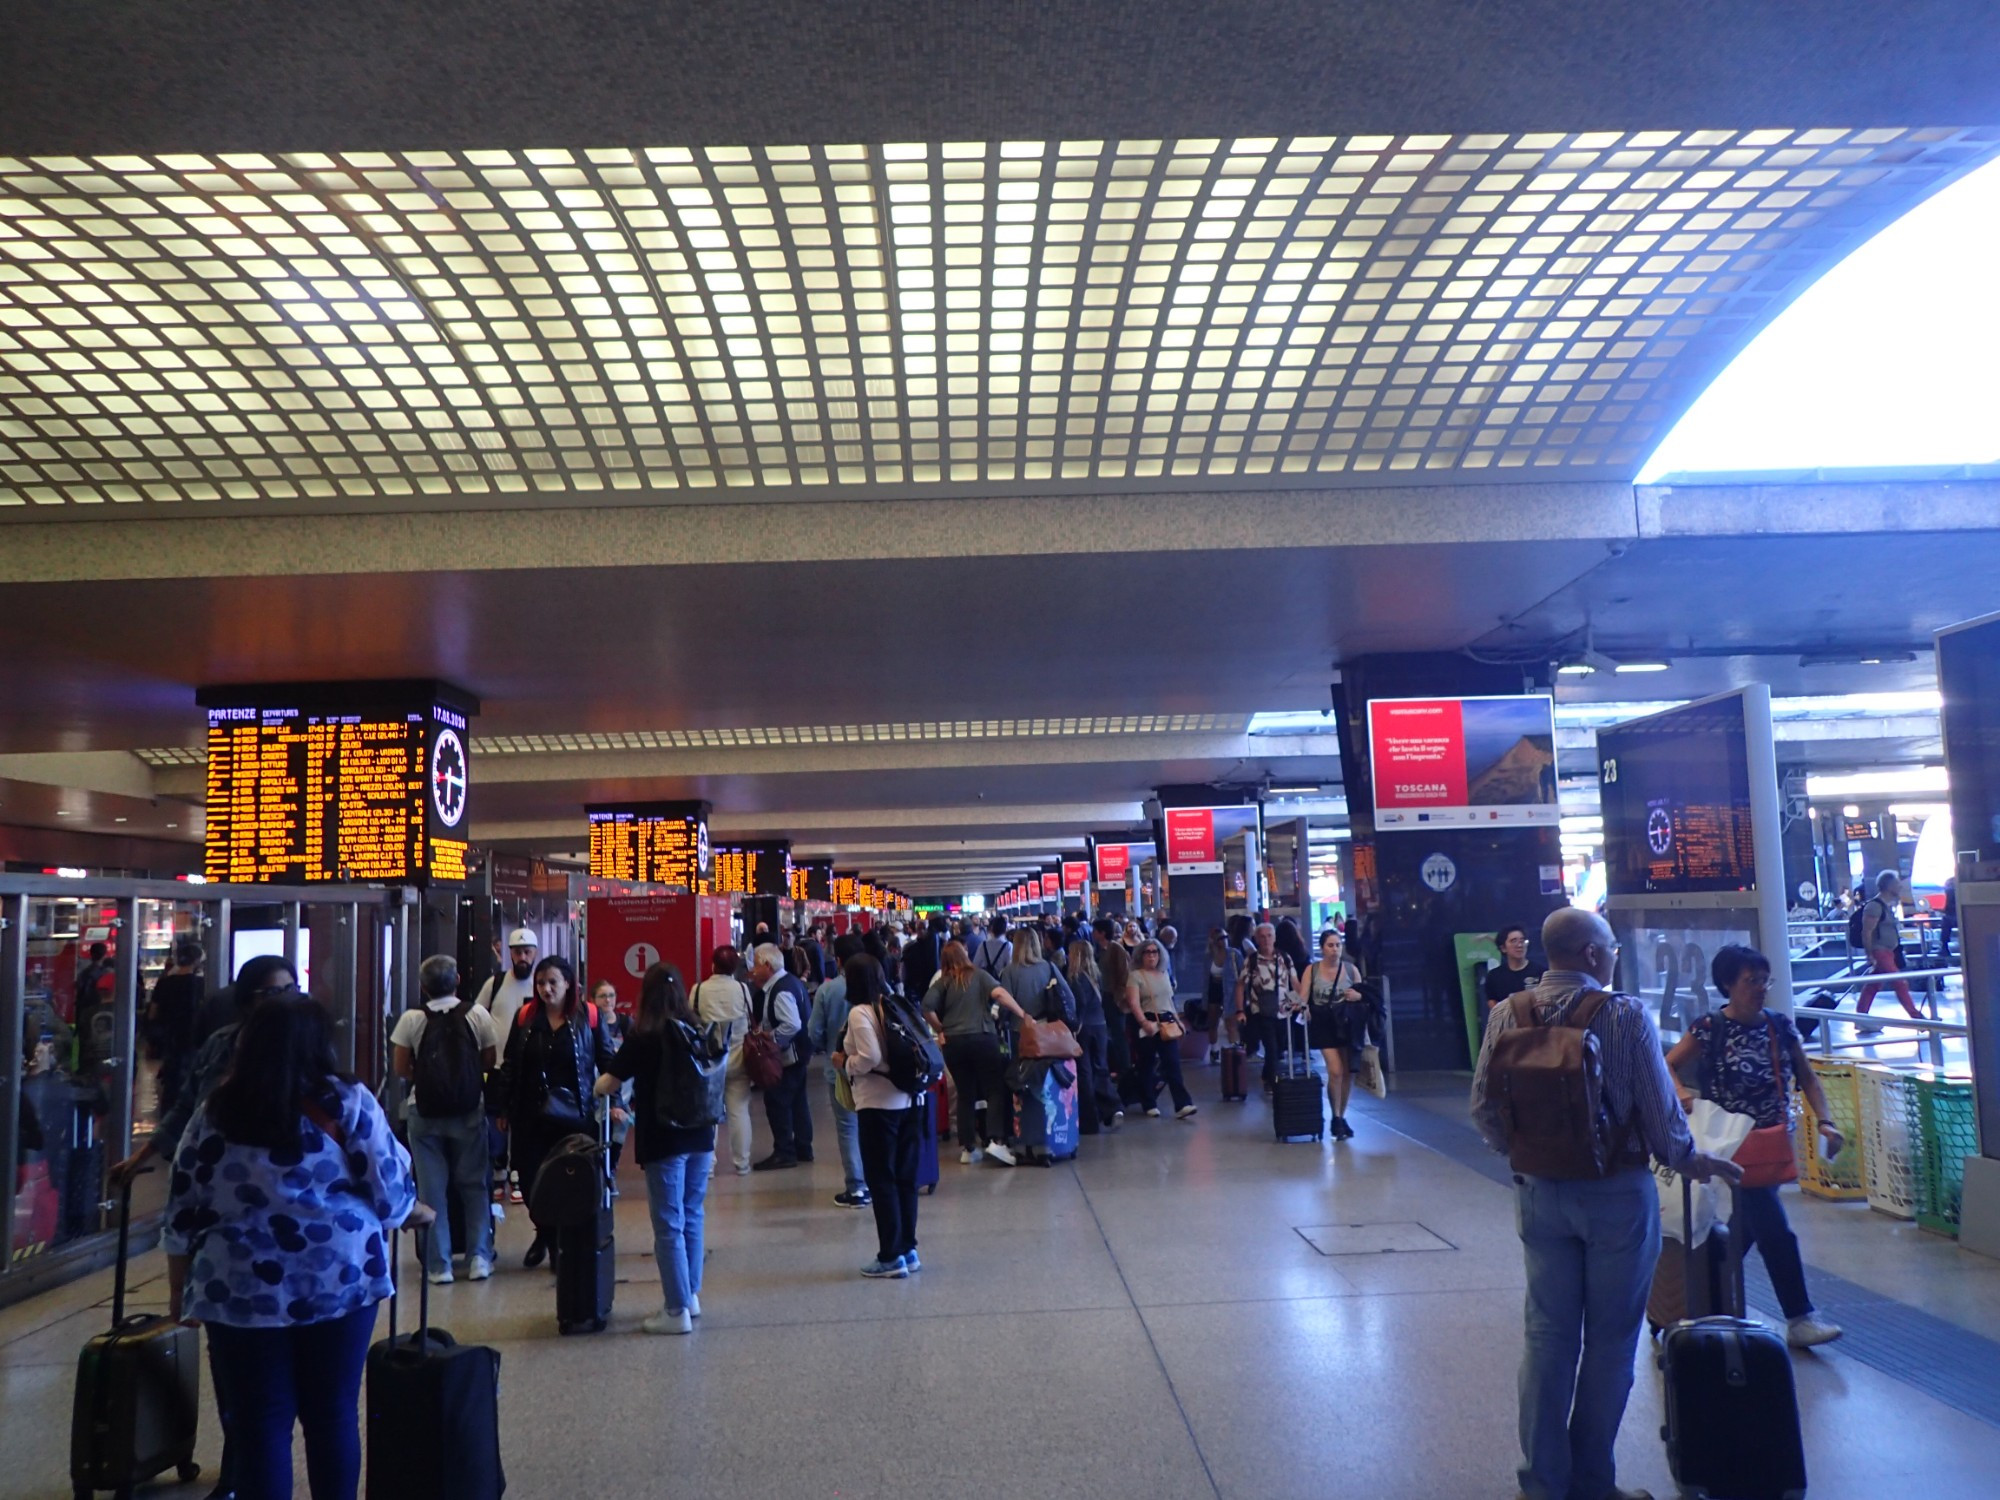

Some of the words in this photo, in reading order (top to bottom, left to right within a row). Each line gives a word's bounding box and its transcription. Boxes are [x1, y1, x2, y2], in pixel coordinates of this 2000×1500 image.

[209, 709, 256, 719] PARTENZE
[261, 752, 287, 760] CASERTA
[1603, 759, 1617, 783] 23
[344, 810, 371, 819] CENTRALE
[353, 844, 381, 852] CENTRALE
[1655, 942, 1709, 1032] 23
[1806, 1115, 1814, 1160] PLASTICA
